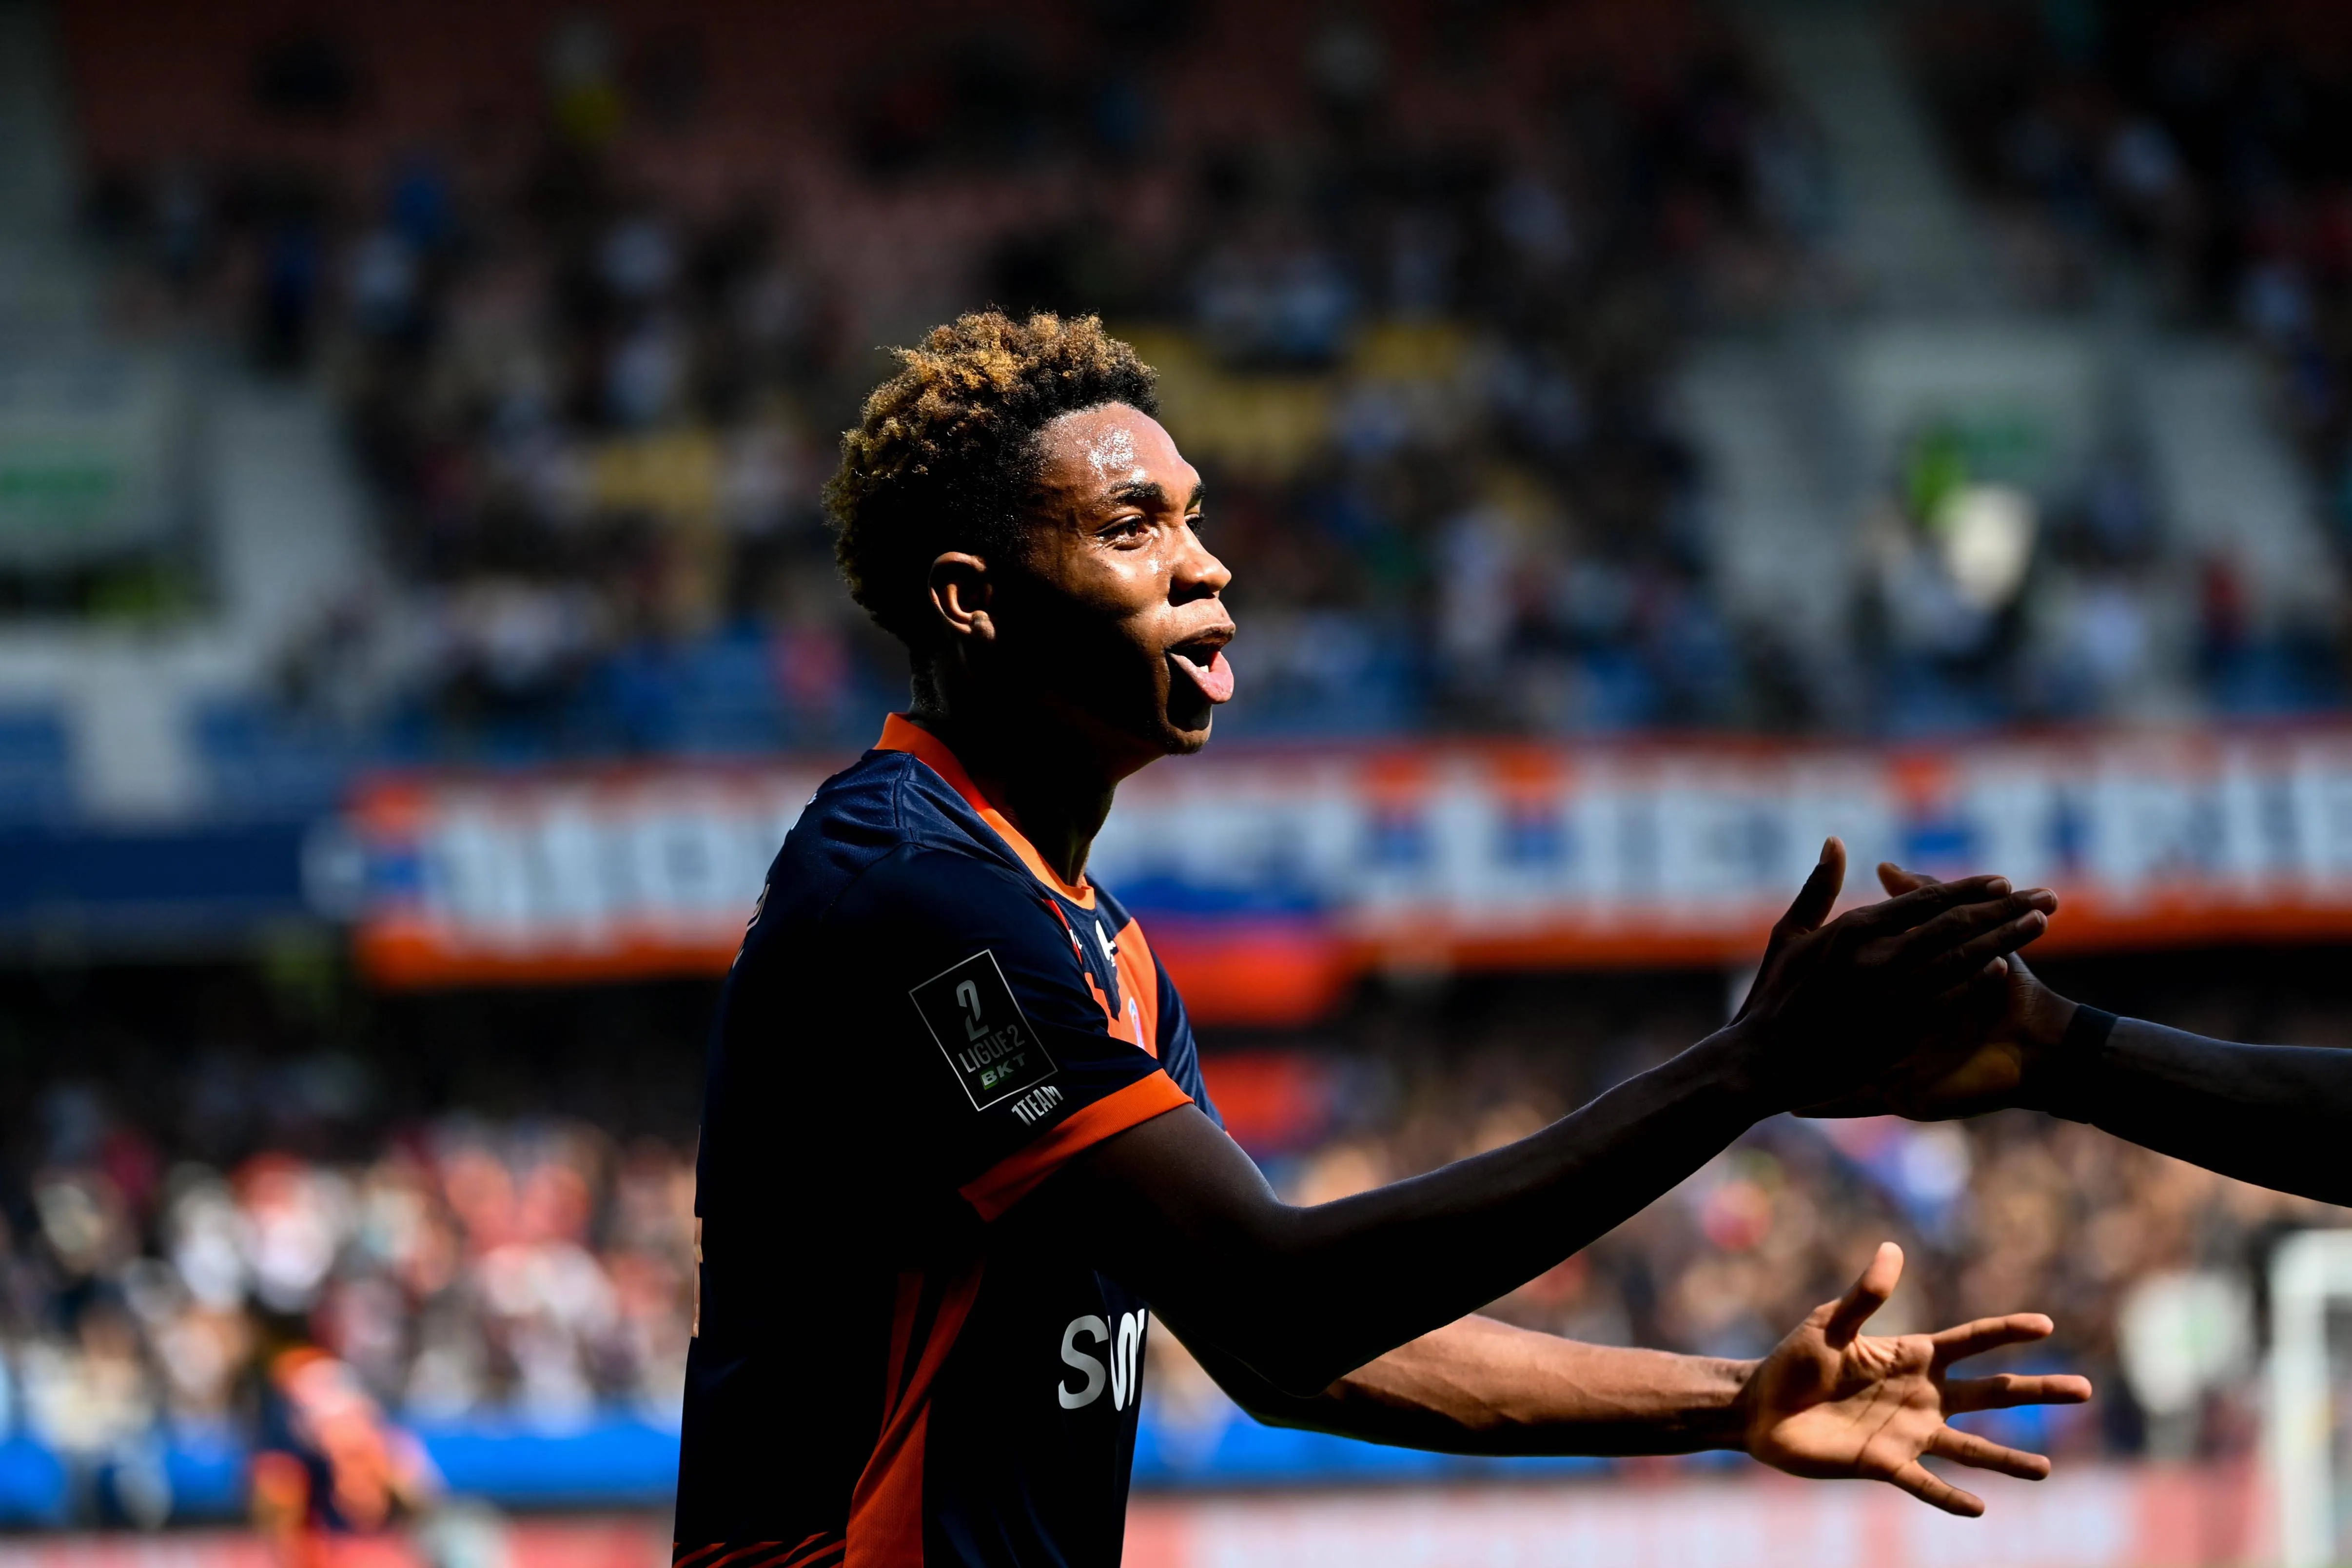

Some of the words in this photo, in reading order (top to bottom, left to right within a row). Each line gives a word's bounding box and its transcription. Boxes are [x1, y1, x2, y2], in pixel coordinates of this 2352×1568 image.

[956, 980, 989, 1042] 2
[981, 1052, 1026, 1086] BKT
[1011, 1085, 1064, 1127] 1TEAM
